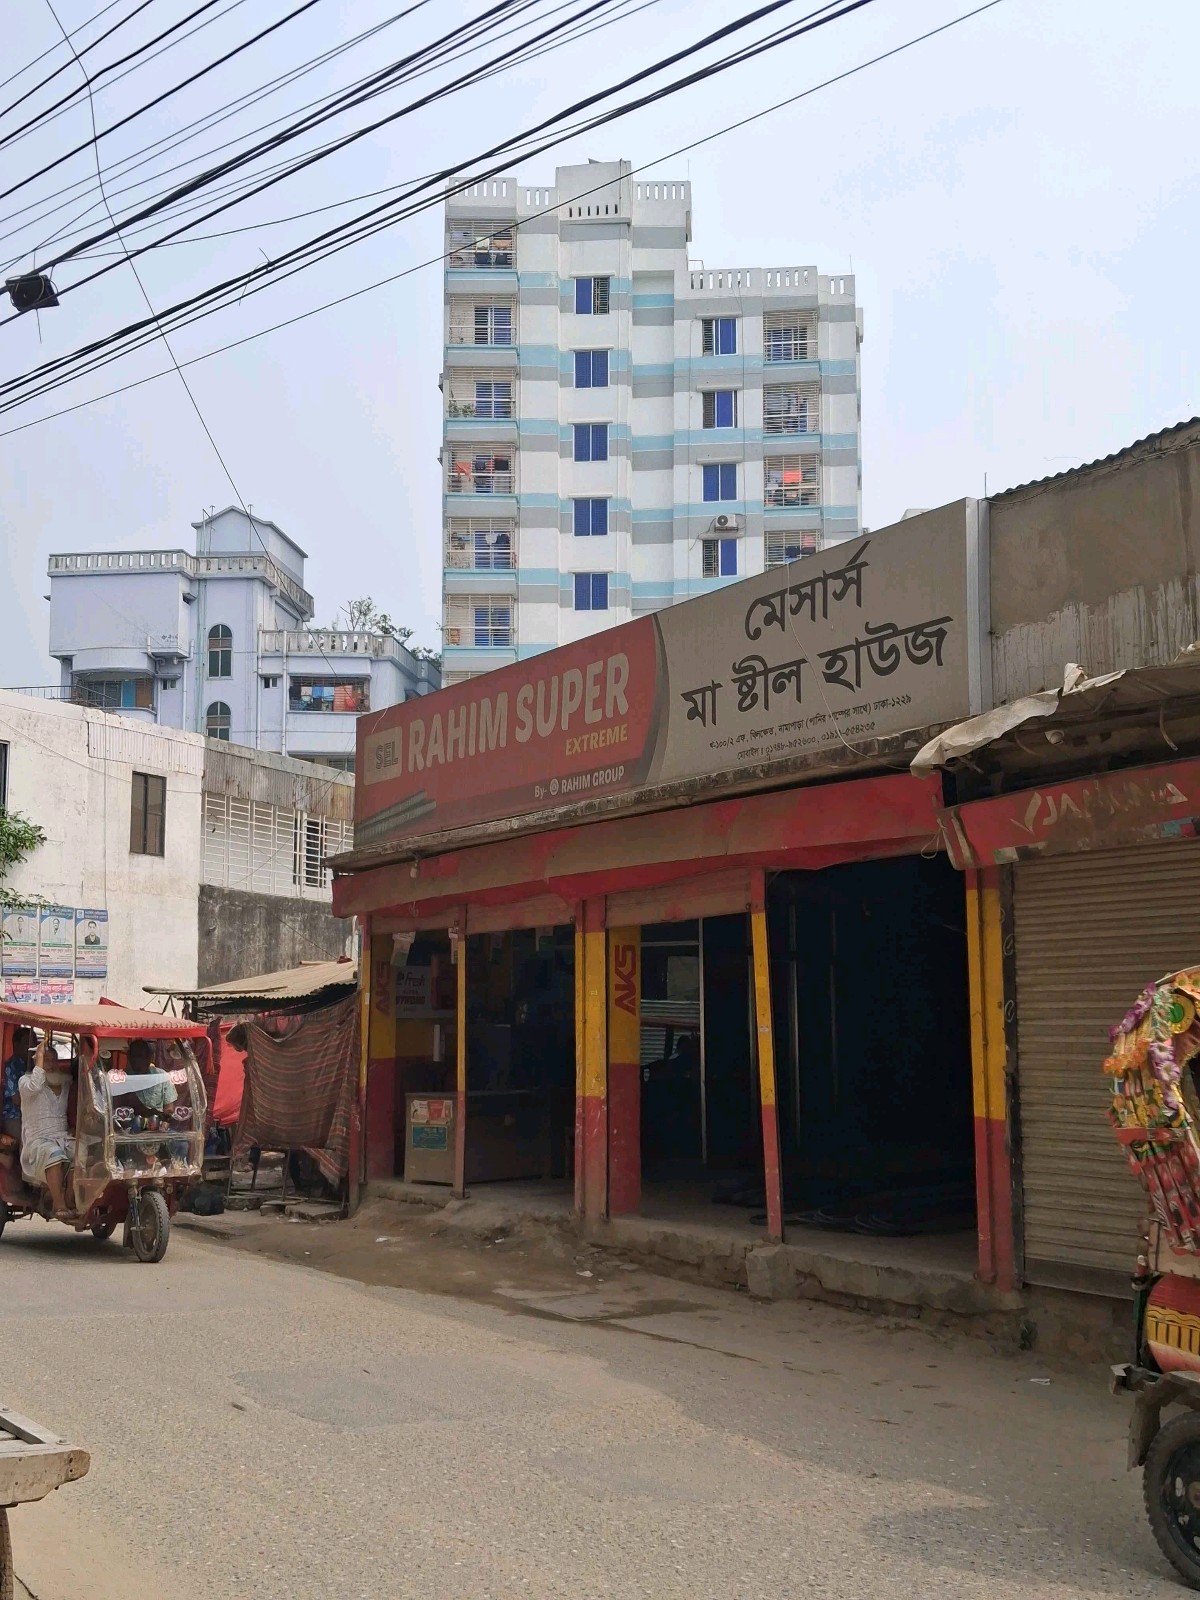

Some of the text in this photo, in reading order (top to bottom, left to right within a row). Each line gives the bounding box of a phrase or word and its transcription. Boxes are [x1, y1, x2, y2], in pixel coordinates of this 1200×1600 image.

[745, 540, 871, 640] মেসার্স
[408, 653, 630, 773] RAHIM SUPER
[680, 615, 954, 728] মা ষ্টীল হাউজ
[561, 773, 591, 794] RAHIM
[592, 765, 625, 787] GROUP
[565, 723, 628, 757] EXTREME
[615, 944, 637, 1016] AKS
